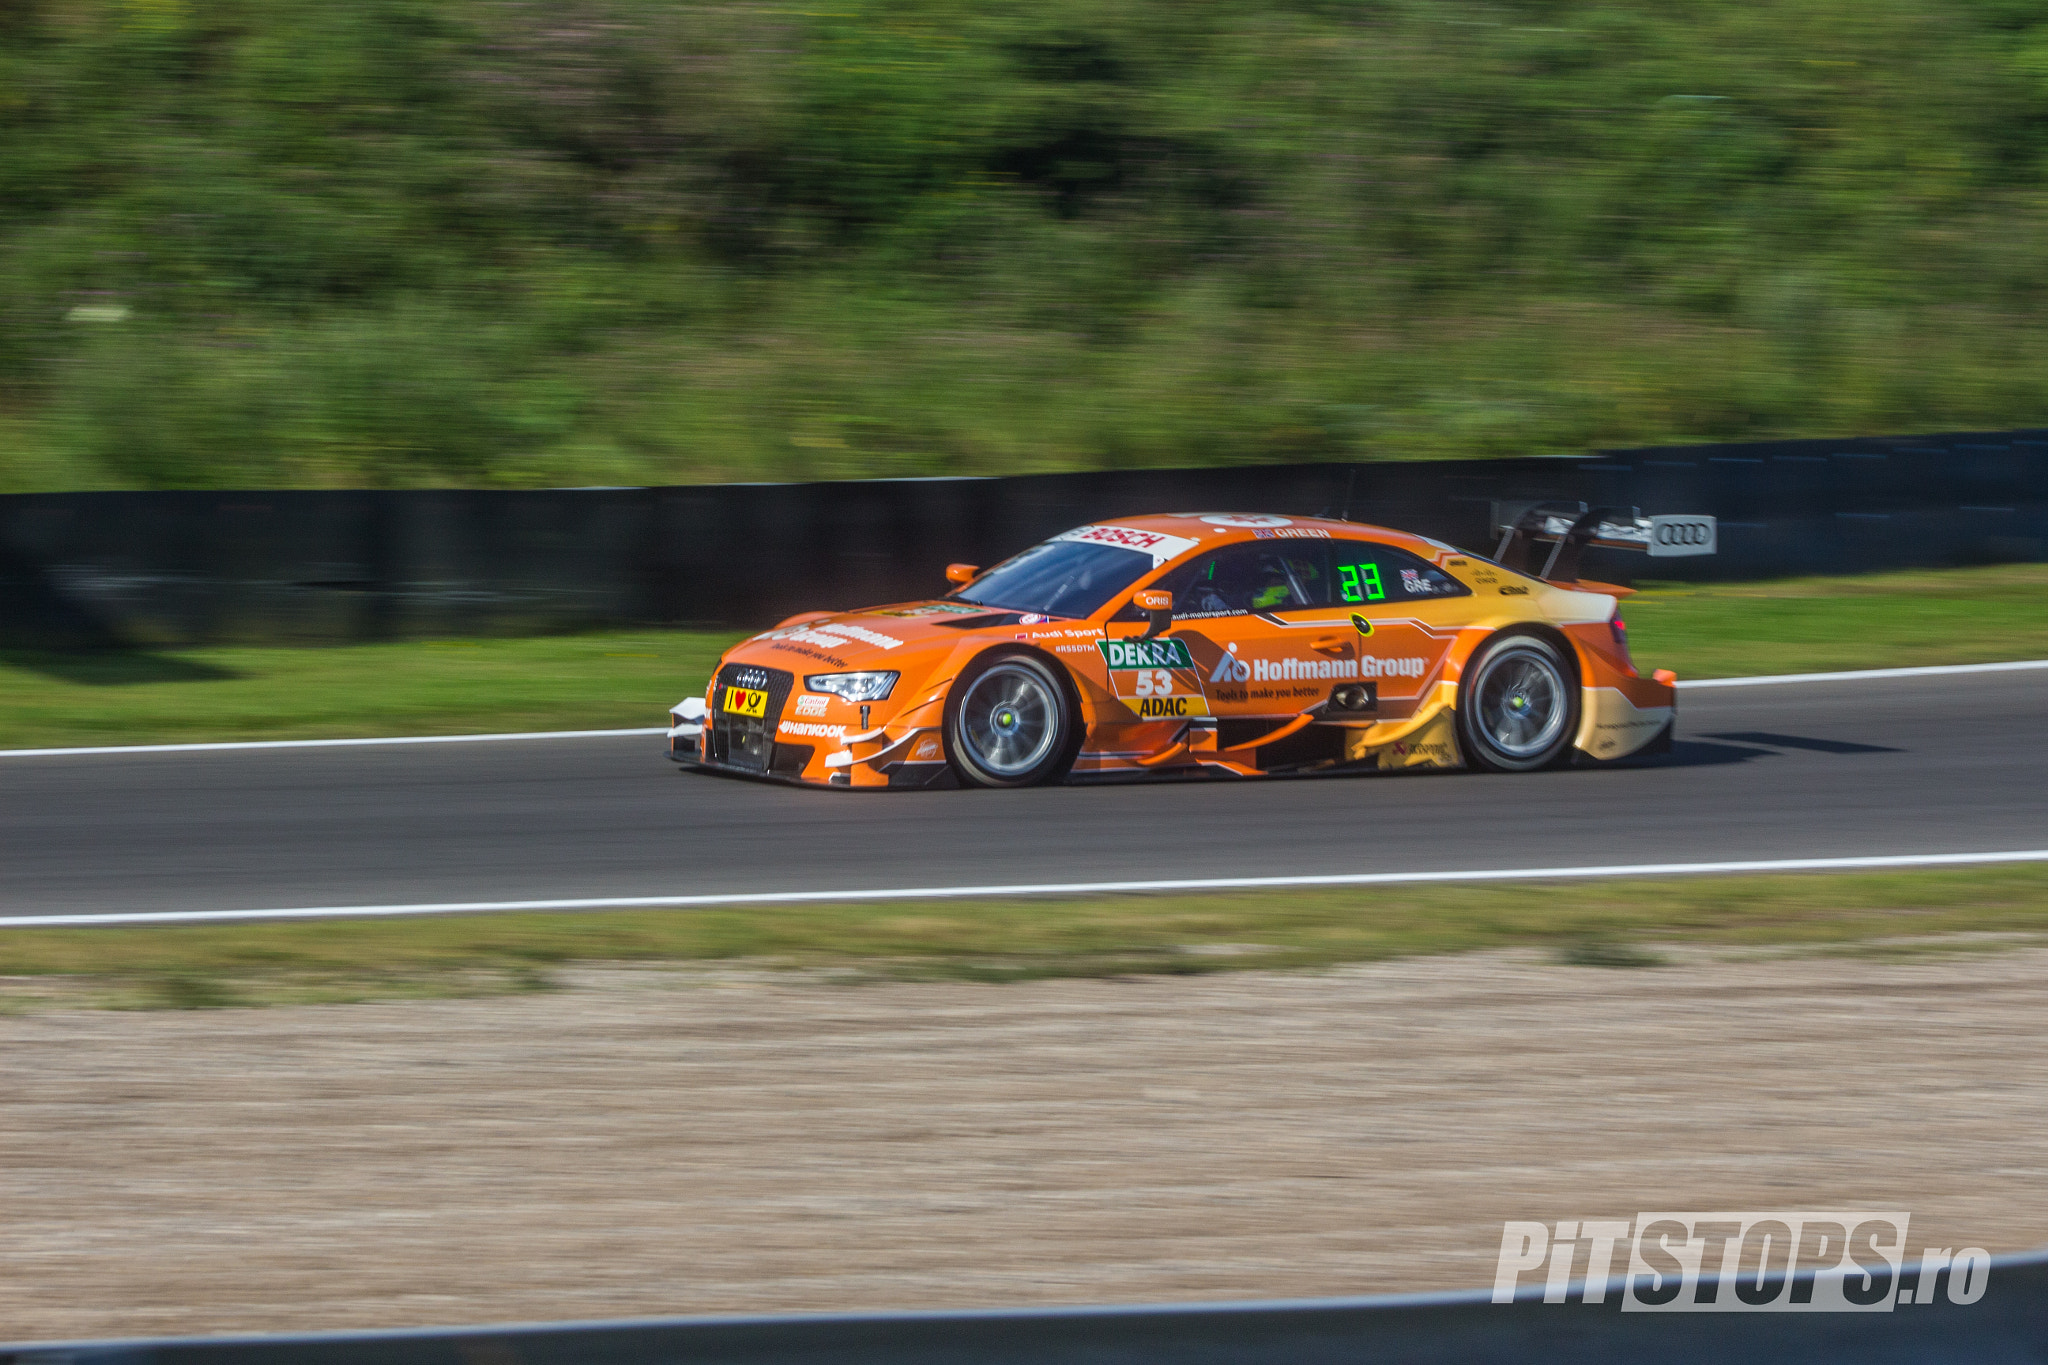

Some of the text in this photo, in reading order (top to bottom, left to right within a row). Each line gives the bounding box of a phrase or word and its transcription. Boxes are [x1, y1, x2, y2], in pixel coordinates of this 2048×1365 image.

[1081, 528, 1165, 548] BOSCH
[1273, 528, 1331, 539] GREEN
[1337, 562, 1386, 602] 23
[1145, 596, 1169, 606] ORIS
[1032, 627, 1105, 639] Audi Sport
[1109, 642, 1181, 667] DEKRA
[1253, 654, 1425, 682] Hoffmann Group
[1135, 670, 1173, 697] 53
[1239, 689, 1249, 700] to
[1250, 687, 1274, 698] make
[1275, 688, 1291, 700] you
[1292, 685, 1320, 697] better
[1139, 697, 1187, 717] ADAC
